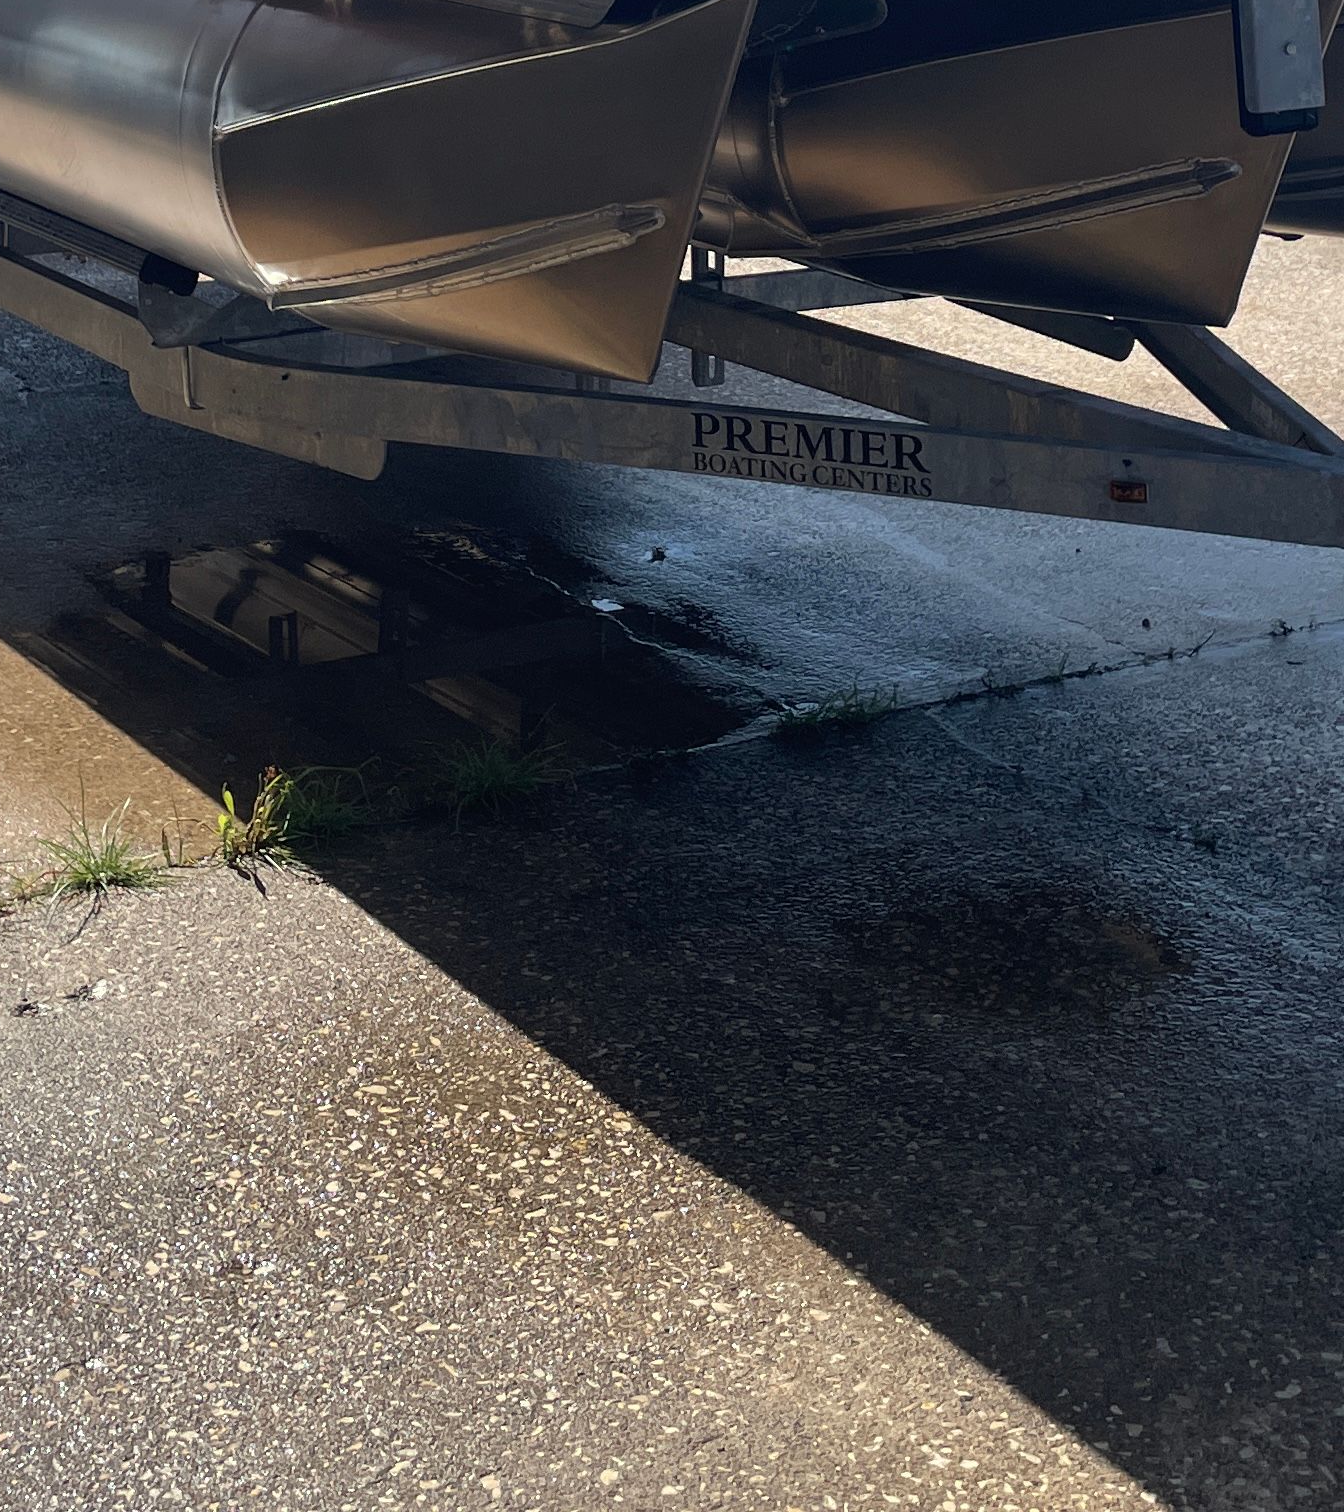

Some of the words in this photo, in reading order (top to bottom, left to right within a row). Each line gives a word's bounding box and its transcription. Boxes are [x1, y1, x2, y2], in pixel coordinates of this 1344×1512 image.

[690, 411, 932, 474] PREMIER
[693, 451, 806, 484] BOATING
[812, 464, 933, 497] CENTERS
